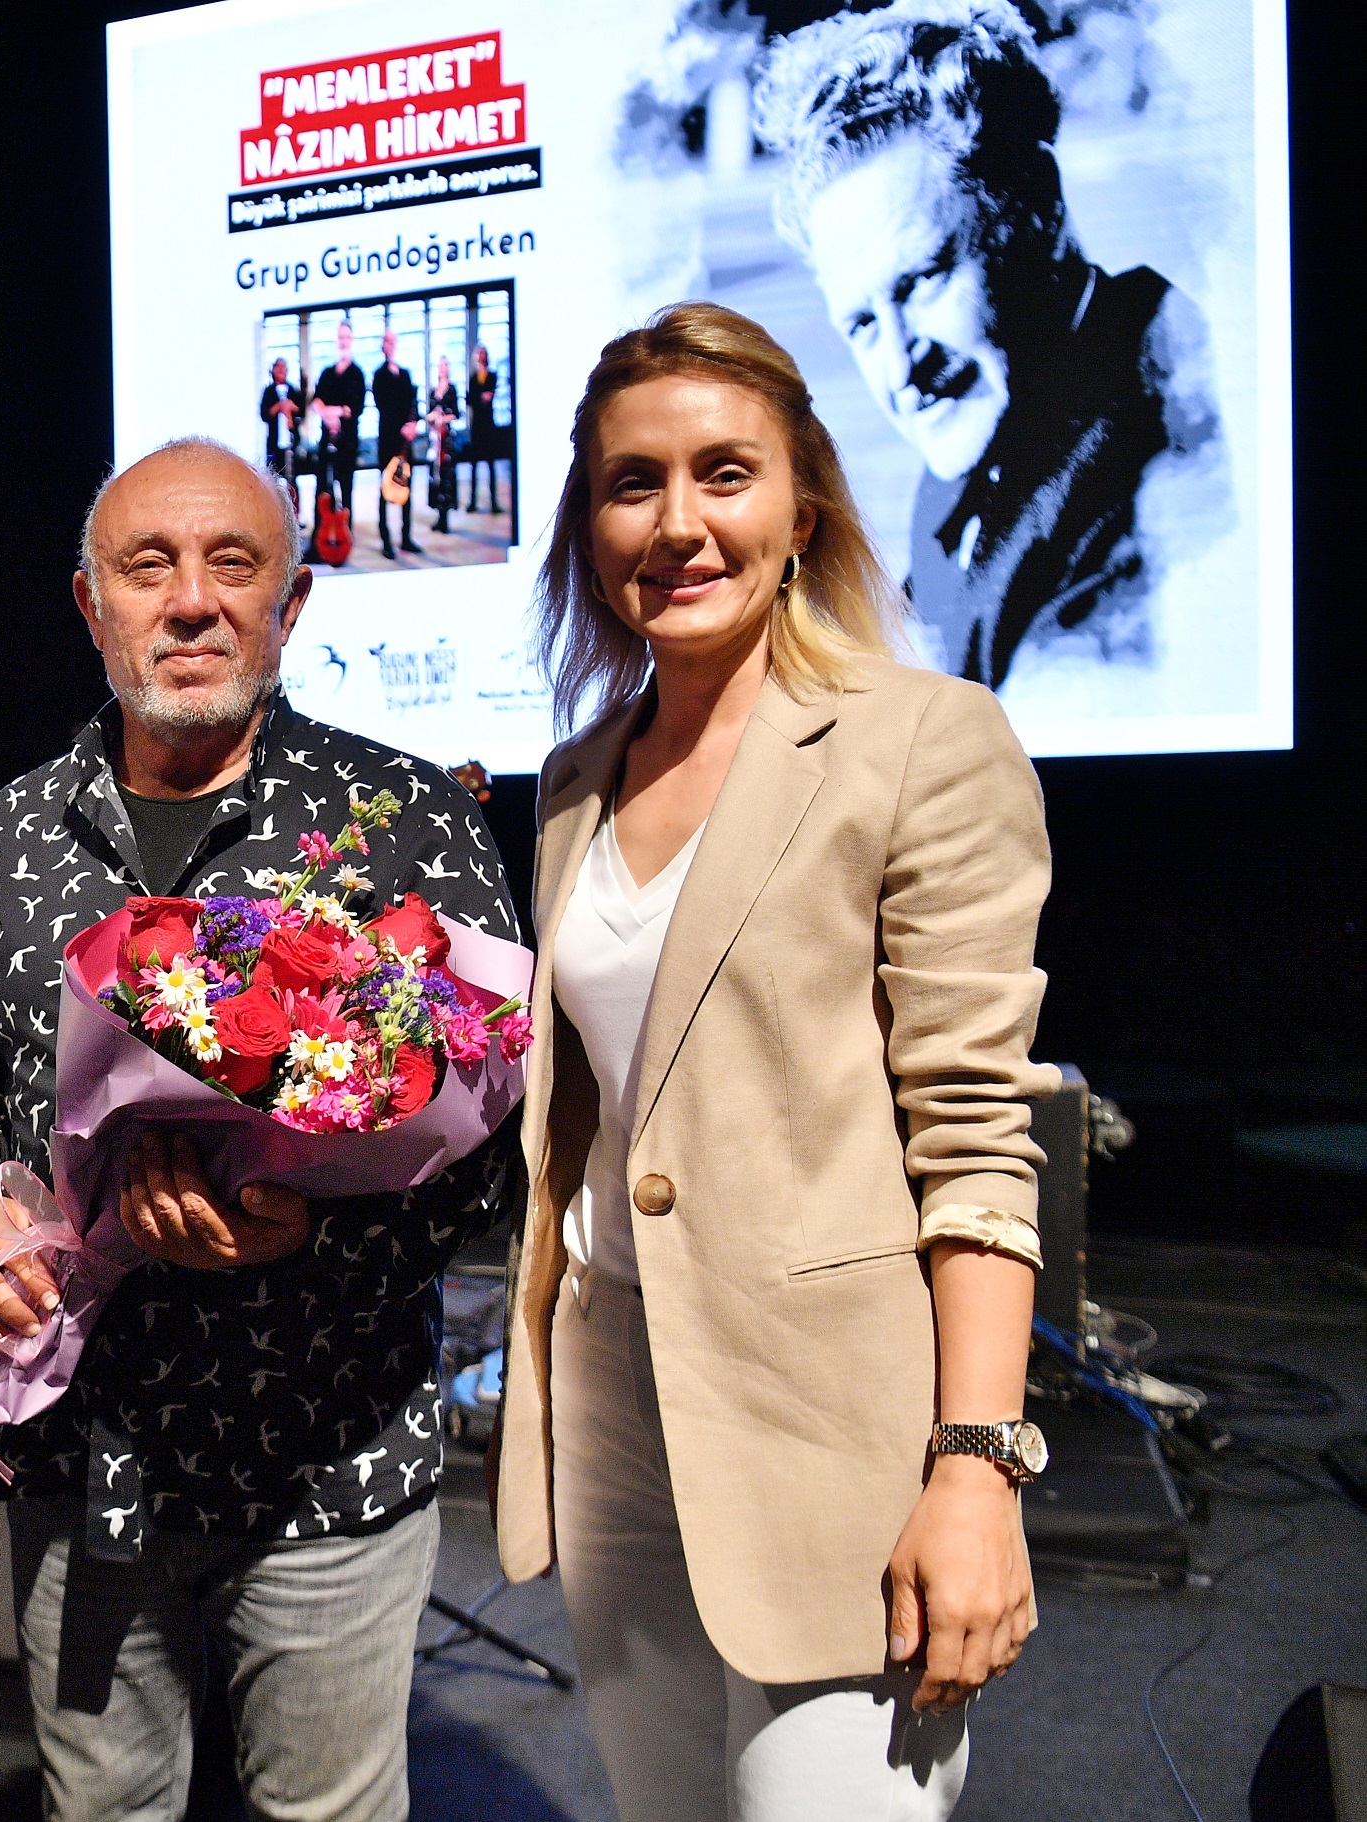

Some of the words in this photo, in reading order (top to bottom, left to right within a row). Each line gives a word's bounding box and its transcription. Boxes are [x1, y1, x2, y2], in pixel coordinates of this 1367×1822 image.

[243, 123, 367, 181] NÂZIM
[375, 103, 522, 160] HİKMET
[236, 258, 309, 292] Grup
[321, 223, 535, 278] Gündoğarken
